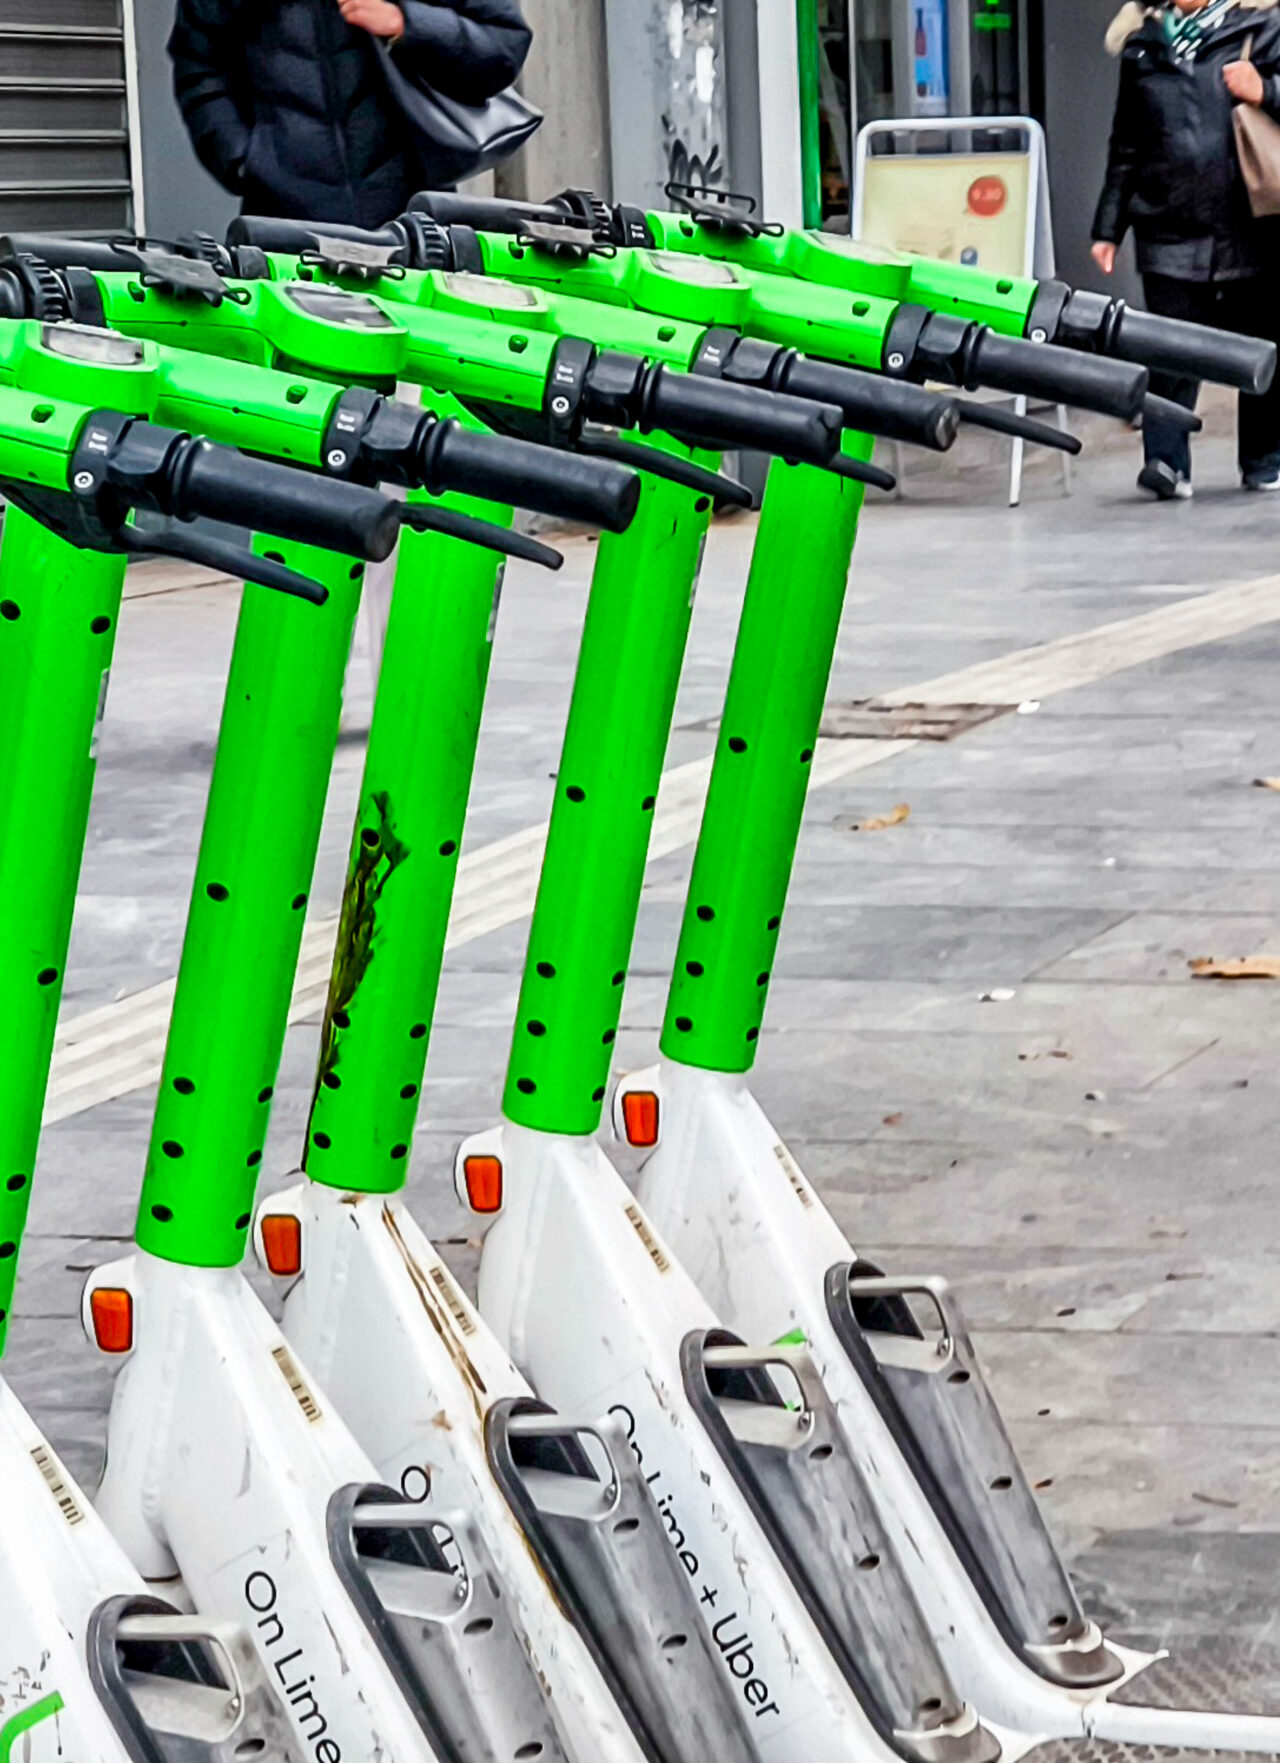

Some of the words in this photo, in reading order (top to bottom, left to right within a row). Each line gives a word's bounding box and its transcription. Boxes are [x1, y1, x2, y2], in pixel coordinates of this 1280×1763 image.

[245, 1571, 284, 1647] On
[274, 1648, 341, 1763] Lime
[712, 1612, 780, 1717] Uber
